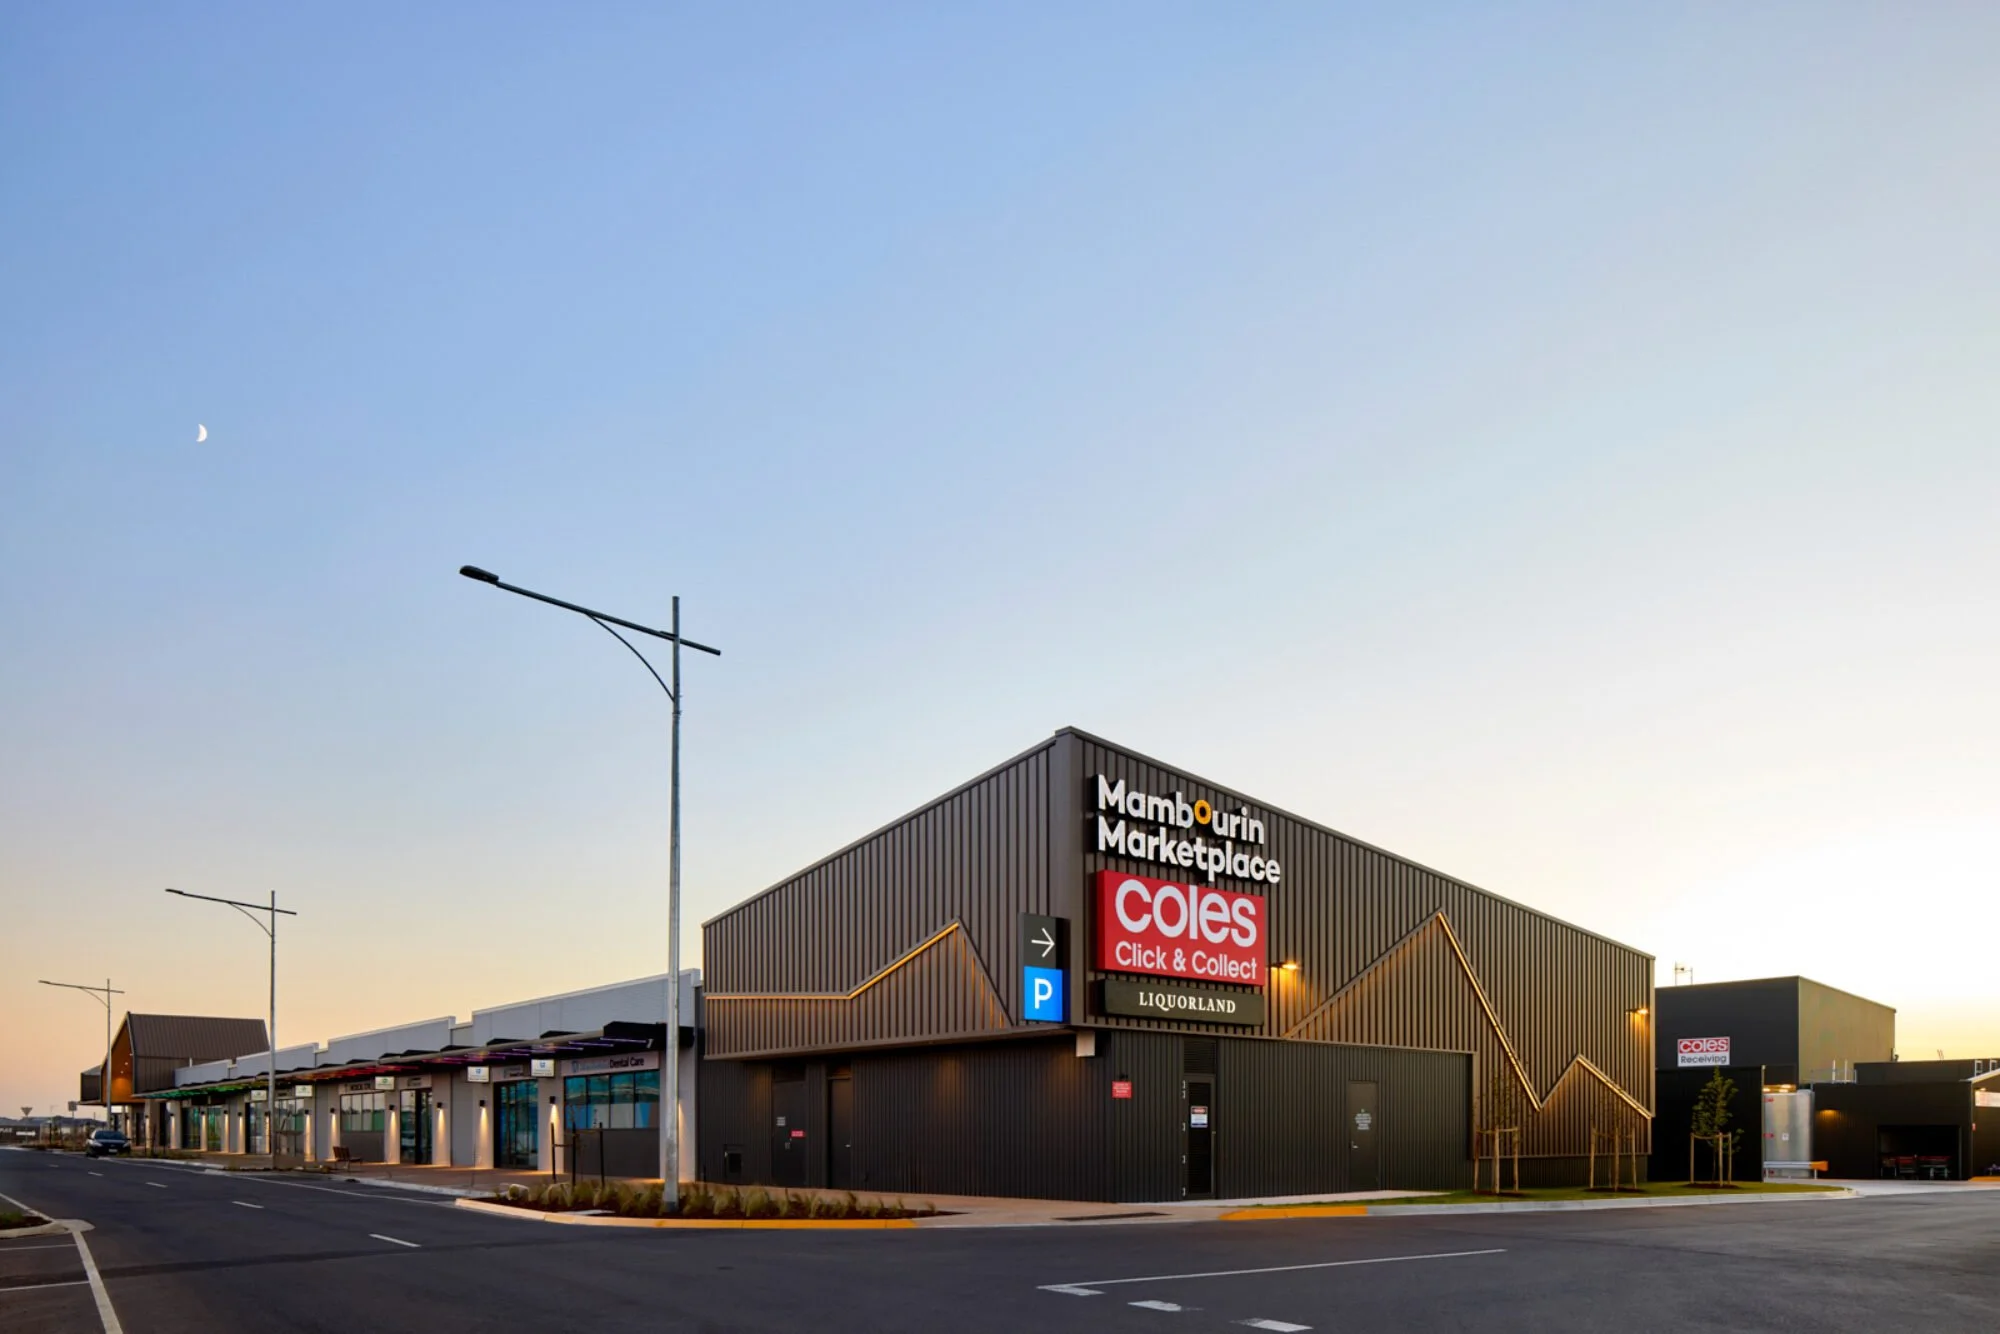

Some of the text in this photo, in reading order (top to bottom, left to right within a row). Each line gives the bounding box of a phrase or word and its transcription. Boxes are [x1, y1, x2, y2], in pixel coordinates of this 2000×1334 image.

[1098, 774, 1264, 844] Mambourin
[1098, 815, 1281, 883] Marketplace
[1115, 879, 1257, 948] coles
[1115, 941, 1257, 979] Click & Collect
[1034, 978, 1053, 1009] P
[1139, 992, 1236, 1013] LIQUORLAND
[1680, 1039, 1728, 1052] coles
[1680, 1054, 1727, 1064] Receiving
[609, 1058, 629, 1069] Dental
[630, 1056, 645, 1067] Care
